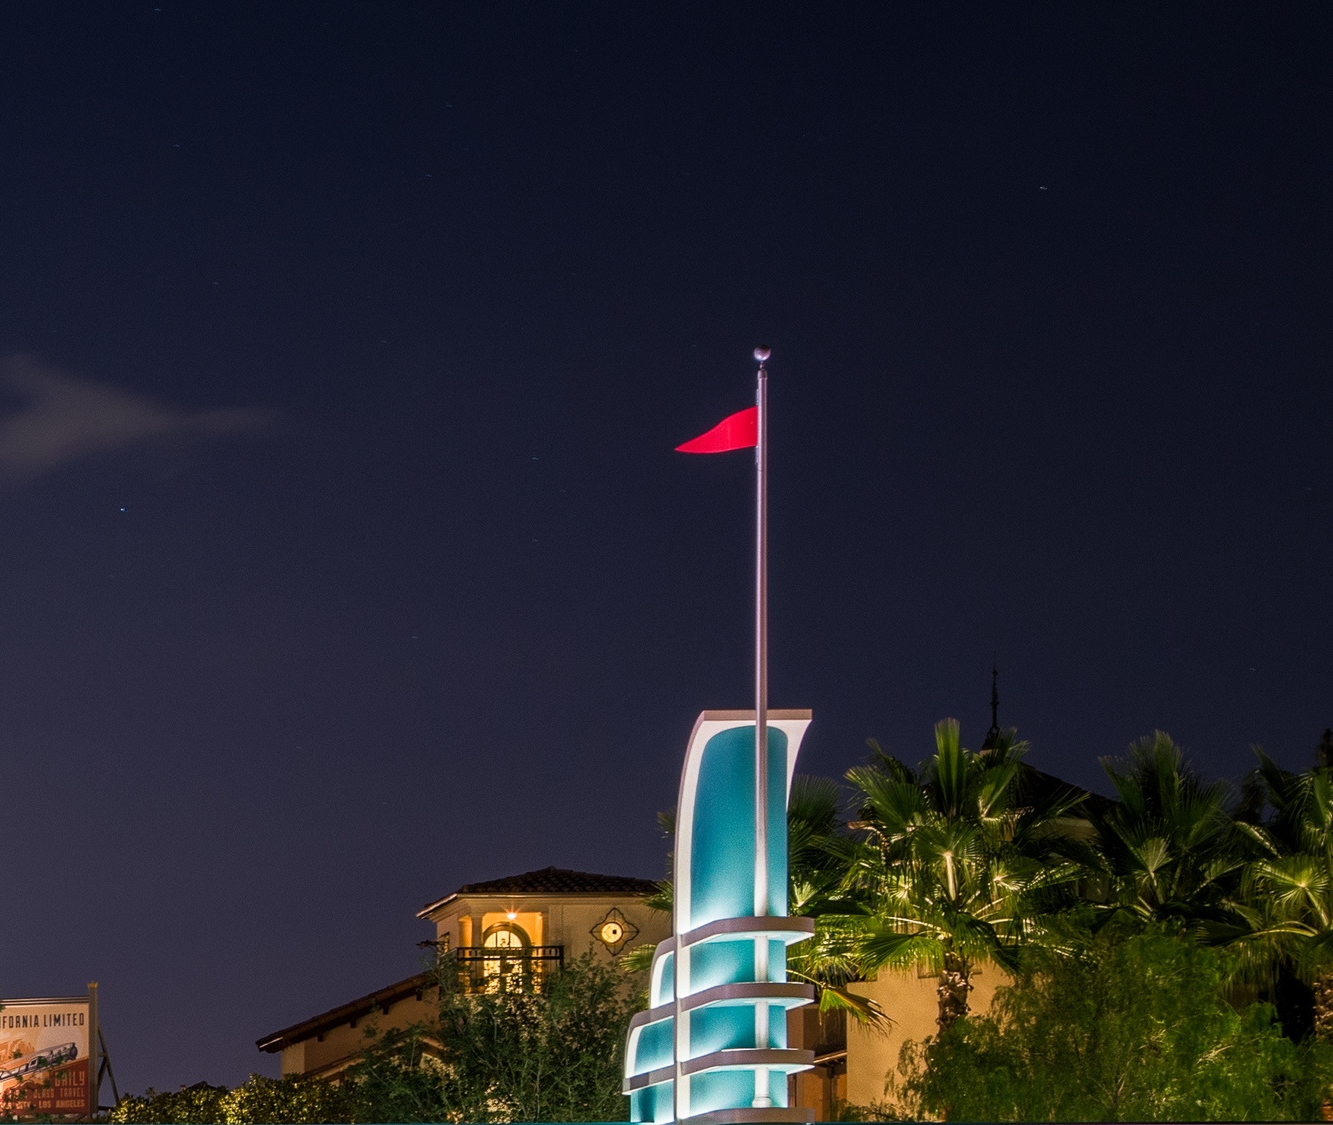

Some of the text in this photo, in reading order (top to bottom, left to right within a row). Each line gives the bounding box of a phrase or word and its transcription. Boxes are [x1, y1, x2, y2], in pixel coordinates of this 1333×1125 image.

[43, 1012, 84, 1027] LIMITED
[60, 1087, 85, 1098] TRAVEL
[38, 1100, 52, 1109] LOS
[55, 1099, 86, 1109] ANGELES
